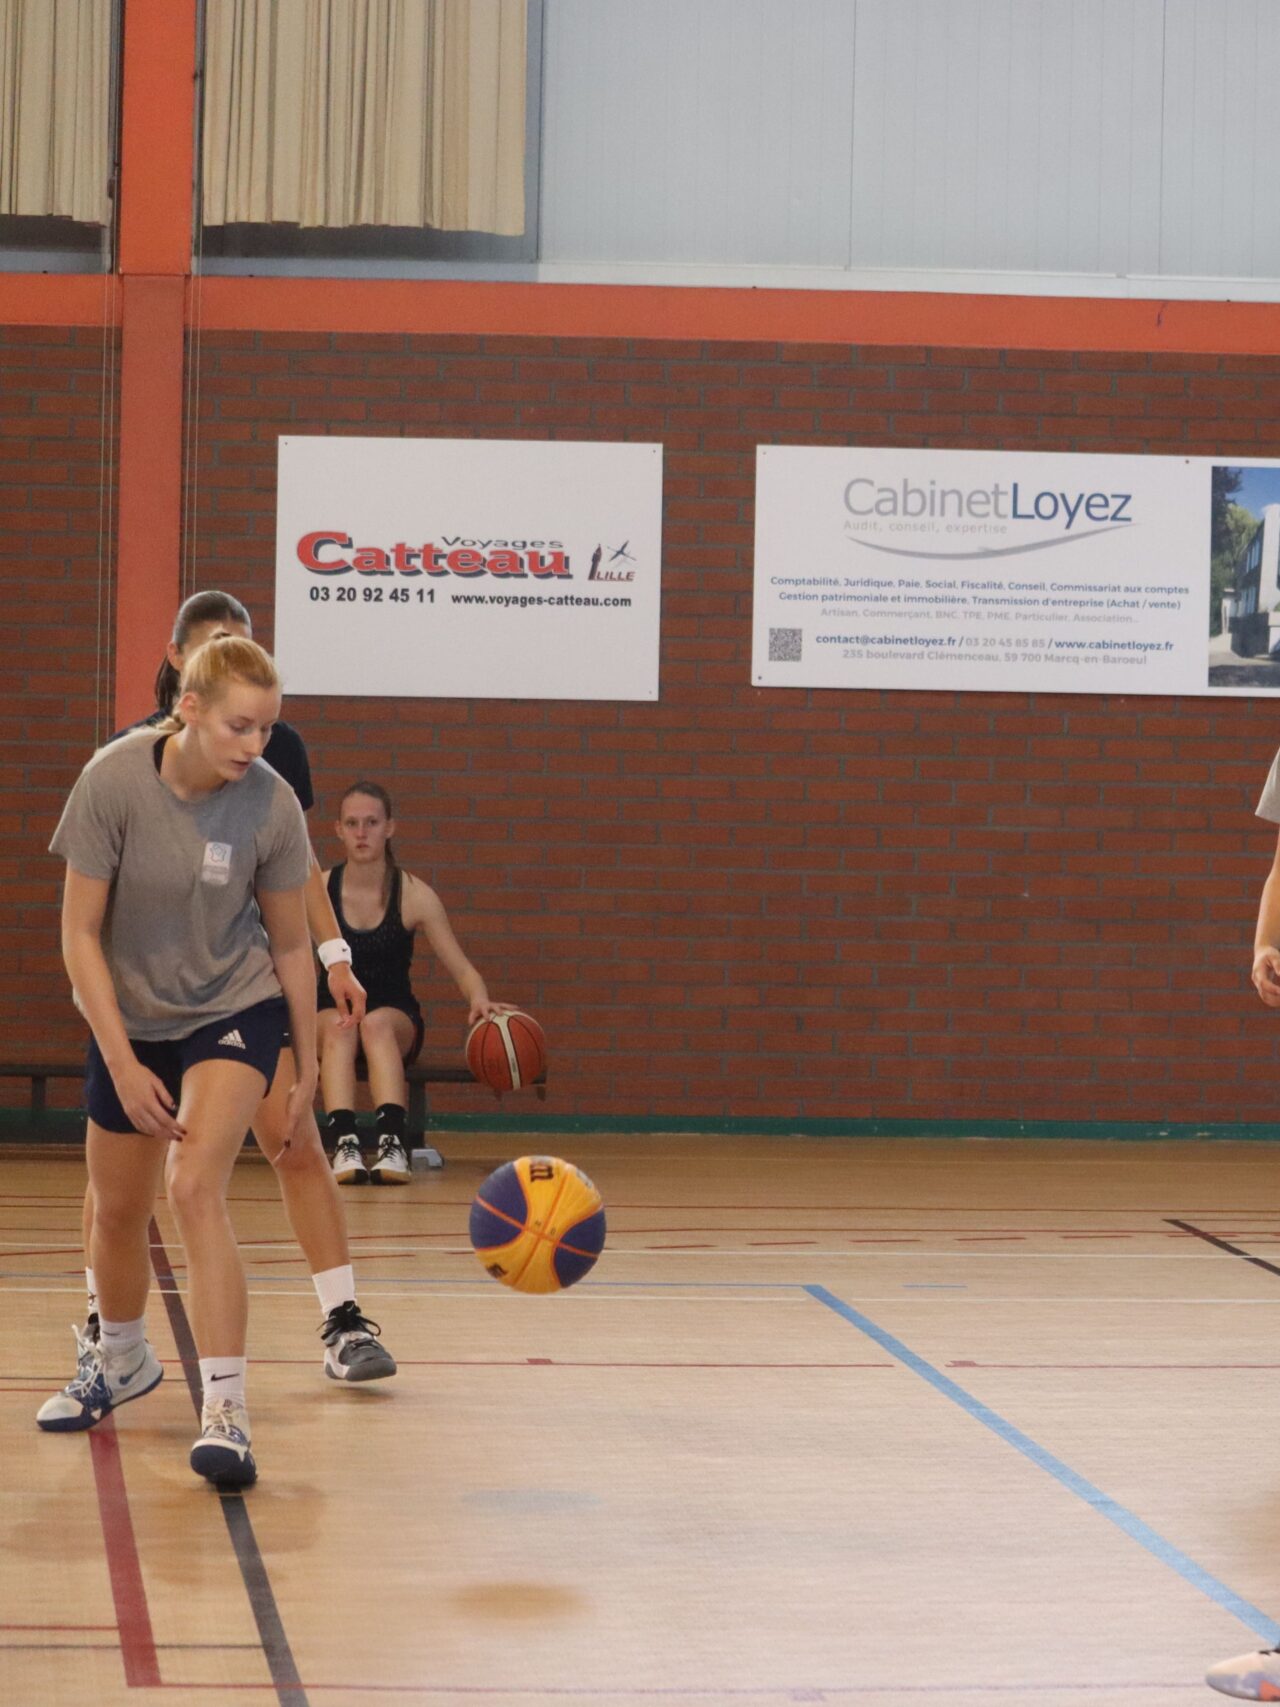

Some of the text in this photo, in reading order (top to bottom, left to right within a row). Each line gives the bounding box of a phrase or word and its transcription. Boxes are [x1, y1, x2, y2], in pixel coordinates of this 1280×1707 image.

[945, 523, 1008, 536] expertise
[441, 536, 563, 551] Voyages
[296, 530, 573, 579] Catteau
[596, 570, 636, 582] LILLE
[1050, 582, 1121, 593] Commissariat
[1124, 585, 1142, 593] aux
[1144, 585, 1190, 596] comptes
[309, 586, 632, 608] 03 20 92 45 11 www.voyages-catteau.com
[779, 592, 819, 602] Gestion
[821, 592, 889, 604] patrimoniale
[891, 594, 902, 603] et
[972, 596, 1039, 606] Transmission
[1107, 598, 1140, 609] (Achat
[1148, 599, 1181, 610] vente)
[815, 634, 957, 648] contact@cabinetloyez.fr
[982, 637, 997, 647] 20
[1055, 639, 1175, 653] www.cabinetloyez.fr
[866, 649, 925, 661] boulevard
[1003, 652, 1018, 662] 59
[1020, 652, 1042, 663] 700
